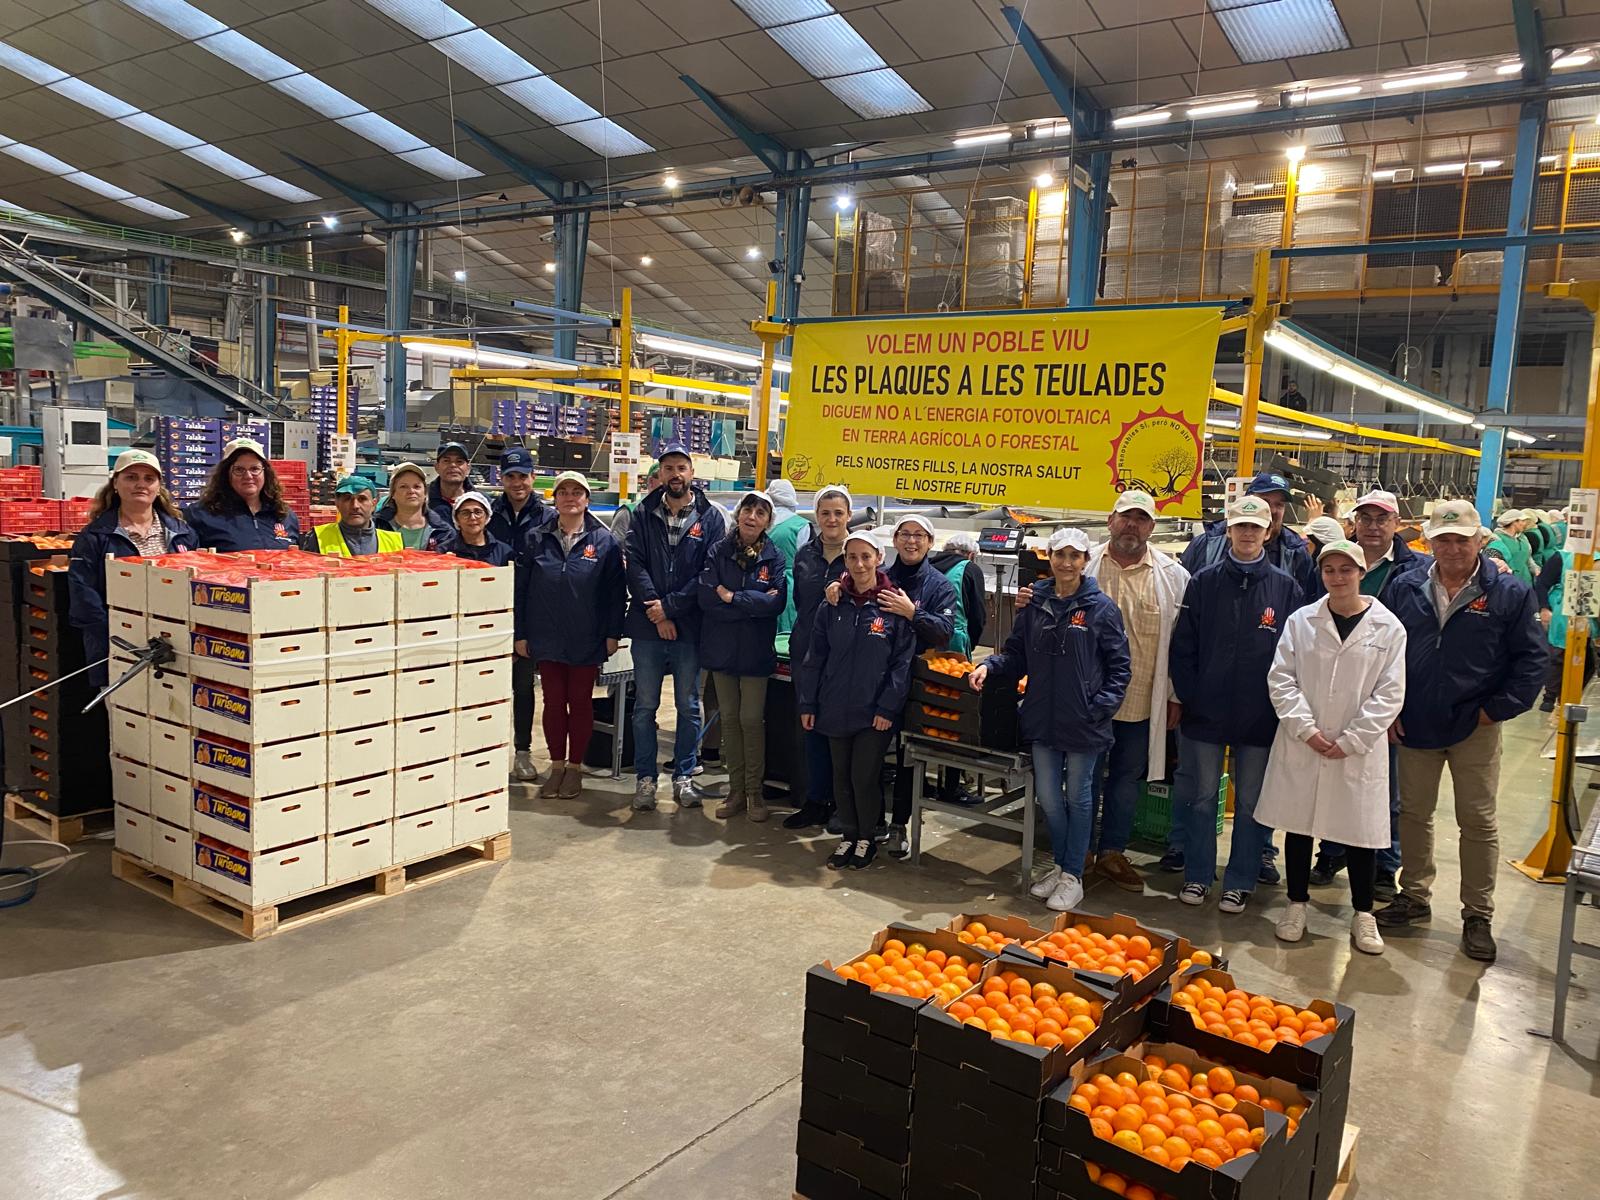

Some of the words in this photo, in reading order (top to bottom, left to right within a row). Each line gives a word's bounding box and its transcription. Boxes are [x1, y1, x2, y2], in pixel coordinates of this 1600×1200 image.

[866, 333, 932, 354] VOLEM
[938, 332, 966, 353] UN
[972, 330, 1045, 353] POBLE
[1052, 328, 1090, 352] VIU
[811, 365, 848, 394] LES
[855, 364, 951, 396] PLAQUES
[957, 364, 973, 396] A
[981, 363, 1025, 396] LES
[1033, 362, 1166, 396] TEULADES
[185, 422, 206, 430] Talaka
[822, 404, 872, 420] DIGUEM
[875, 404, 899, 421] NO
[903, 406, 912, 421] A
[993, 408, 1111, 425] FOTOVOLTAICA
[842, 428, 860, 442] EN
[863, 429, 907, 445] TERRA
[909, 428, 982, 448] AGRÍCOLA
[985, 433, 997, 448] O
[1000, 433, 1079, 451] FORESTAL
[1118, 429, 1139, 468] Renovables
[1170, 422, 1180, 431] NO
[835, 455, 863, 468] PELS
[866, 456, 920, 472] NOSTRES
[922, 460, 958, 476] FILLS,
[961, 462, 977, 475] LA
[980, 462, 1033, 478] NOSTRA
[1036, 465, 1082, 480] SALUT
[895, 477, 910, 490] EL
[912, 479, 962, 494] NOSTRE
[964, 482, 1007, 497] FUTUR
